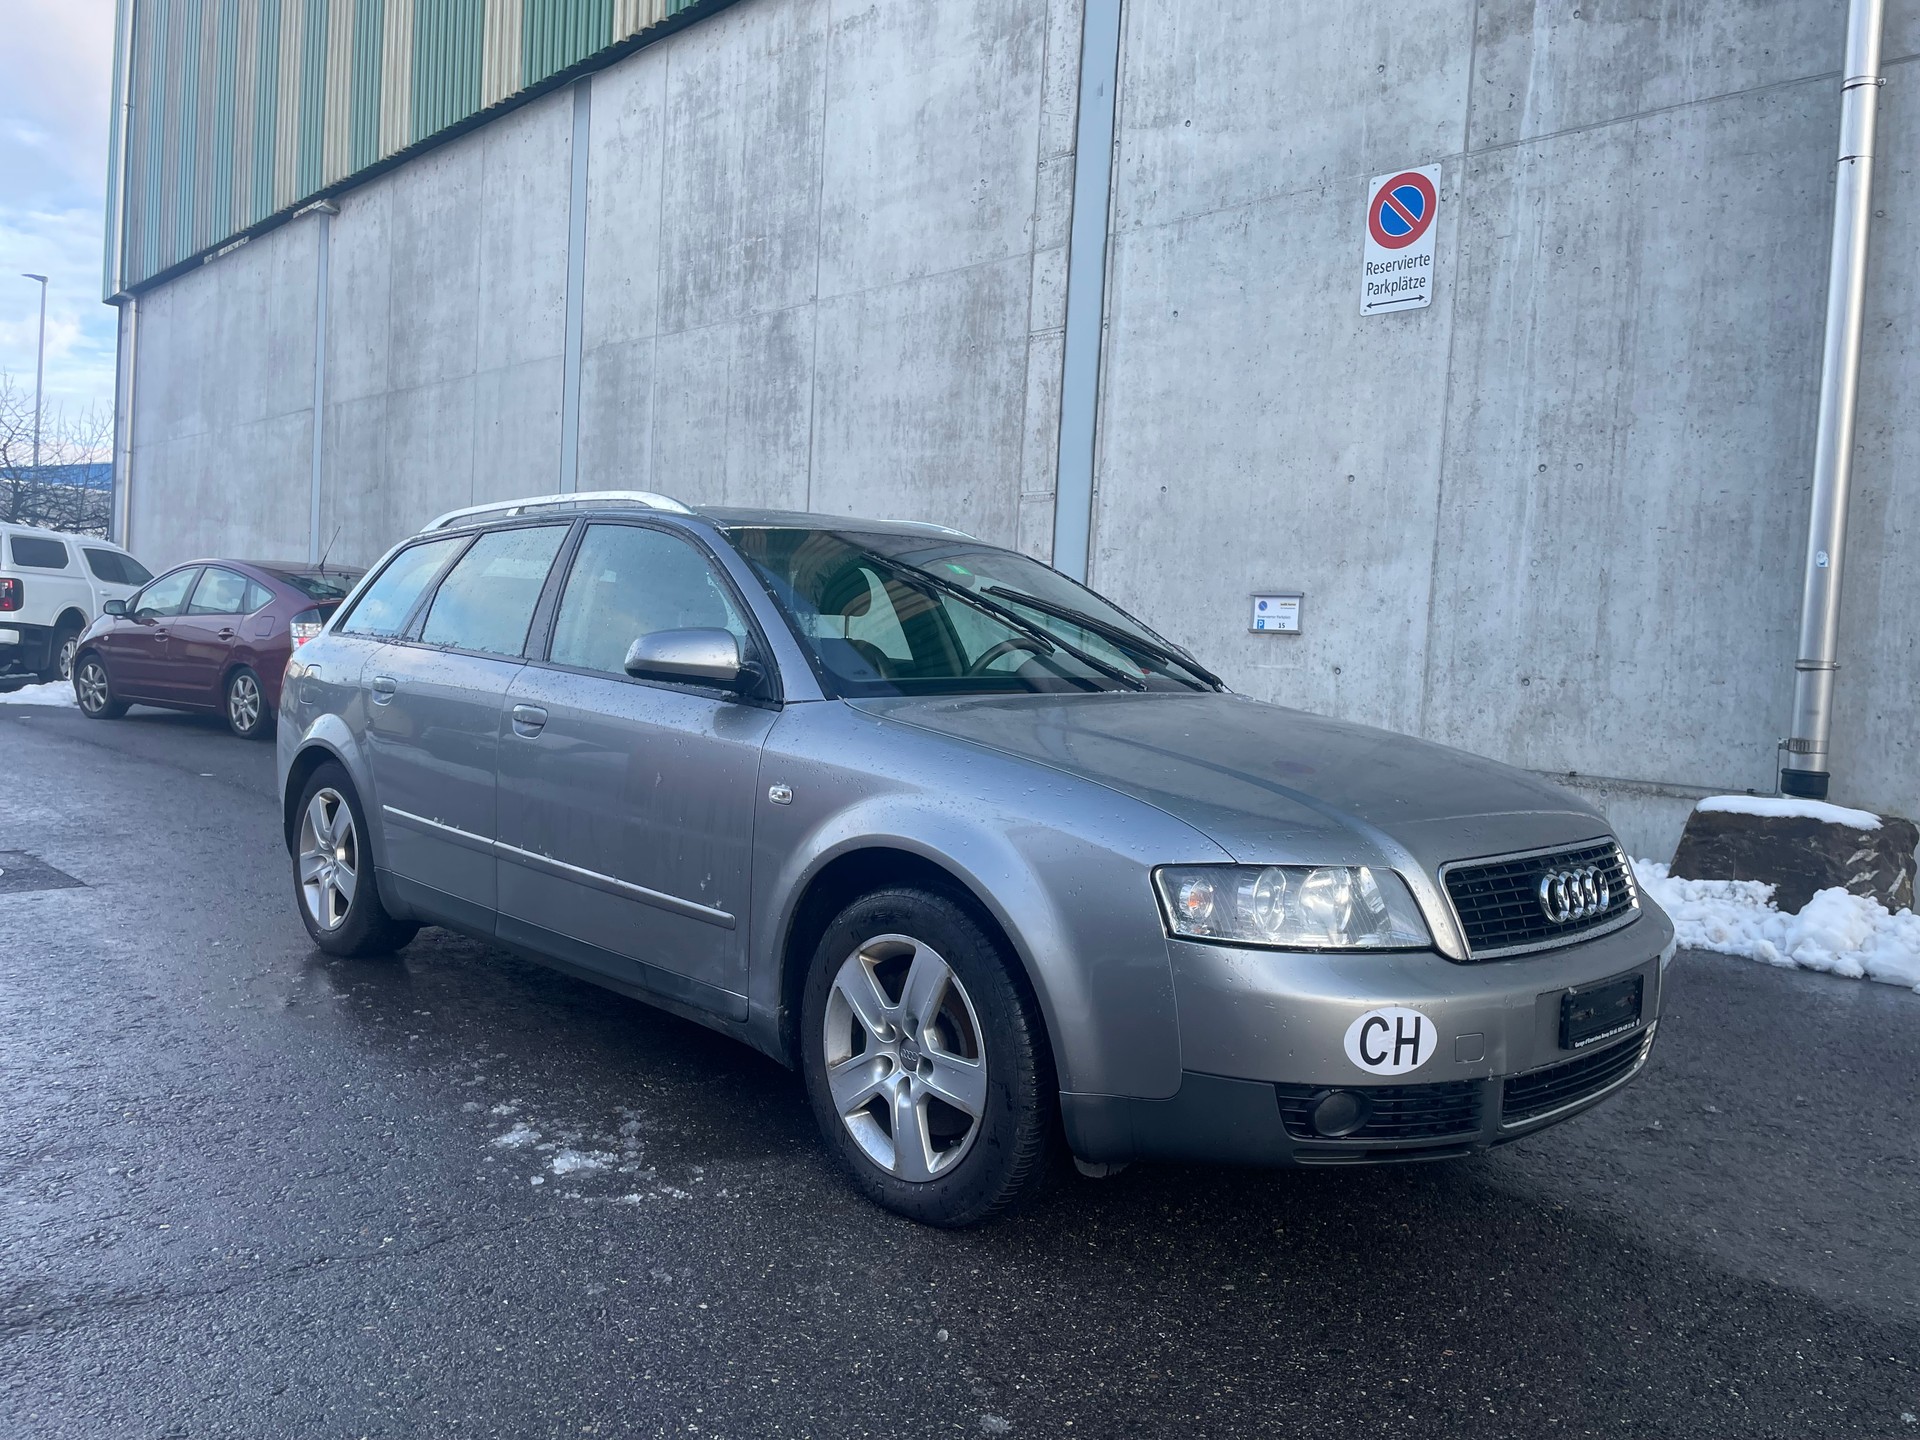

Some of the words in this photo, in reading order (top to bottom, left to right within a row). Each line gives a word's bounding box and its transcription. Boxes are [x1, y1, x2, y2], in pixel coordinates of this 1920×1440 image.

[1366, 253, 1431, 276] Reservierte
[1367, 276, 1426, 297] Parkplätze
[1359, 1016, 1421, 1066] CH
